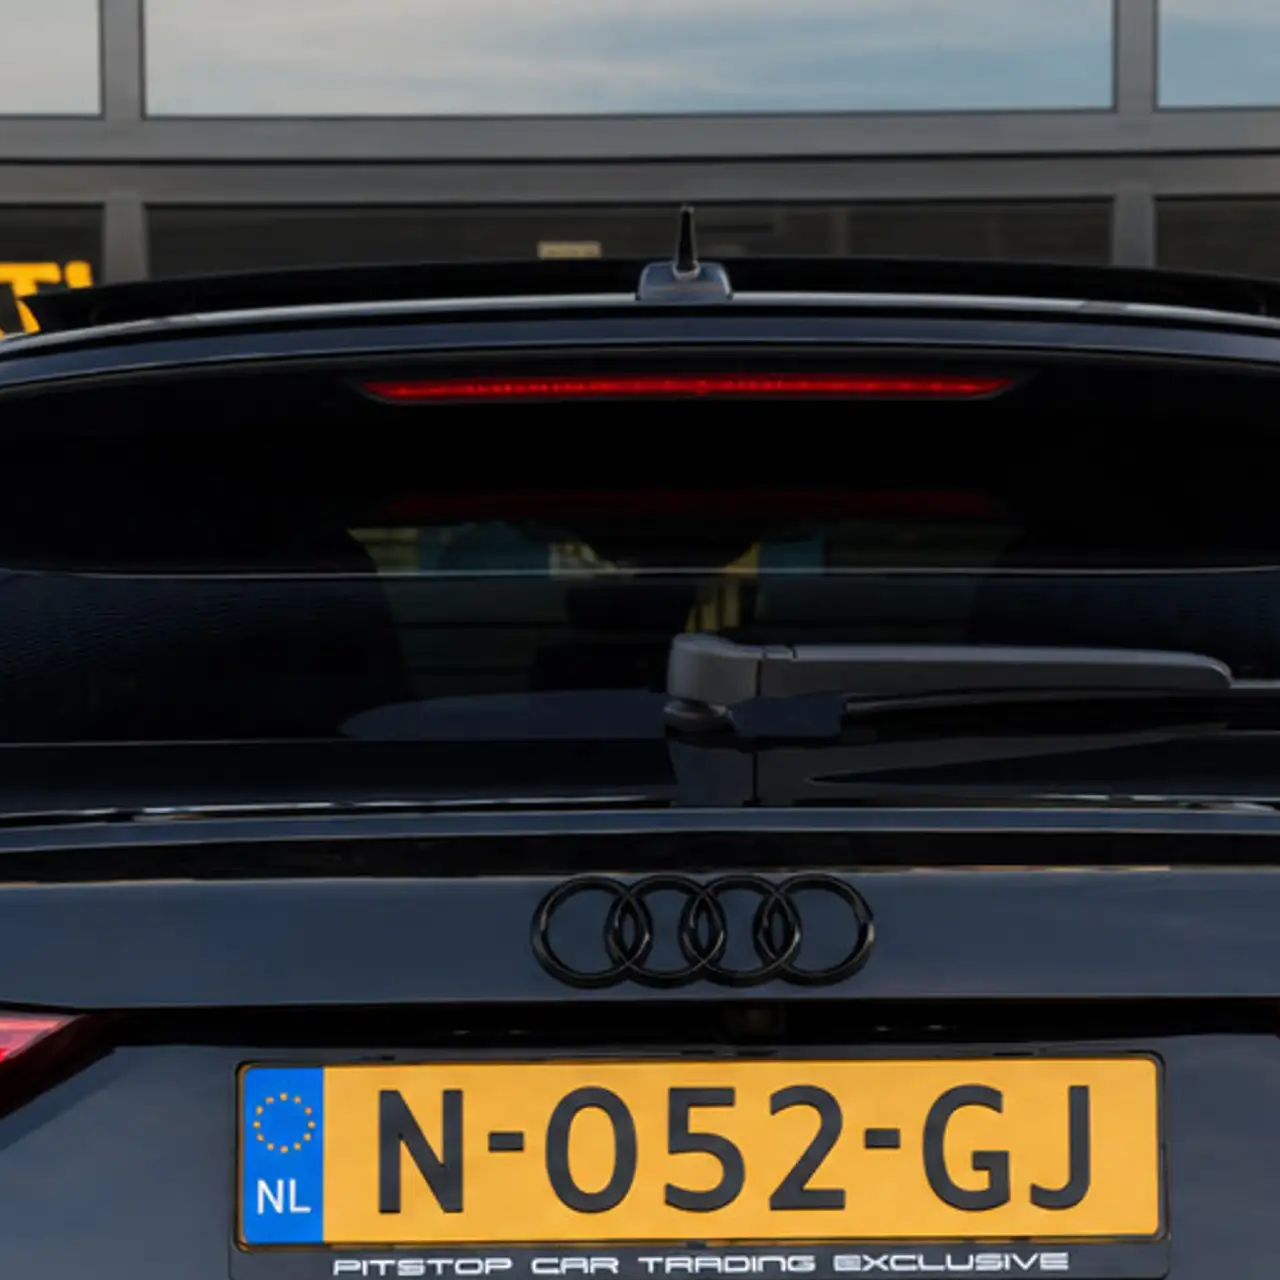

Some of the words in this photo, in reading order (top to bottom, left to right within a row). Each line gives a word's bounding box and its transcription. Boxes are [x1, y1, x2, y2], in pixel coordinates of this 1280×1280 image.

[378, 1085, 1092, 1214] N-052-GJ
[257, 1179, 312, 1214] NL
[332, 1257, 514, 1277] PITSTOP
[530, 1256, 620, 1275] CAR
[637, 1254, 816, 1274] TRADING
[832, 1252, 1069, 1272] EXCLUSIVE
